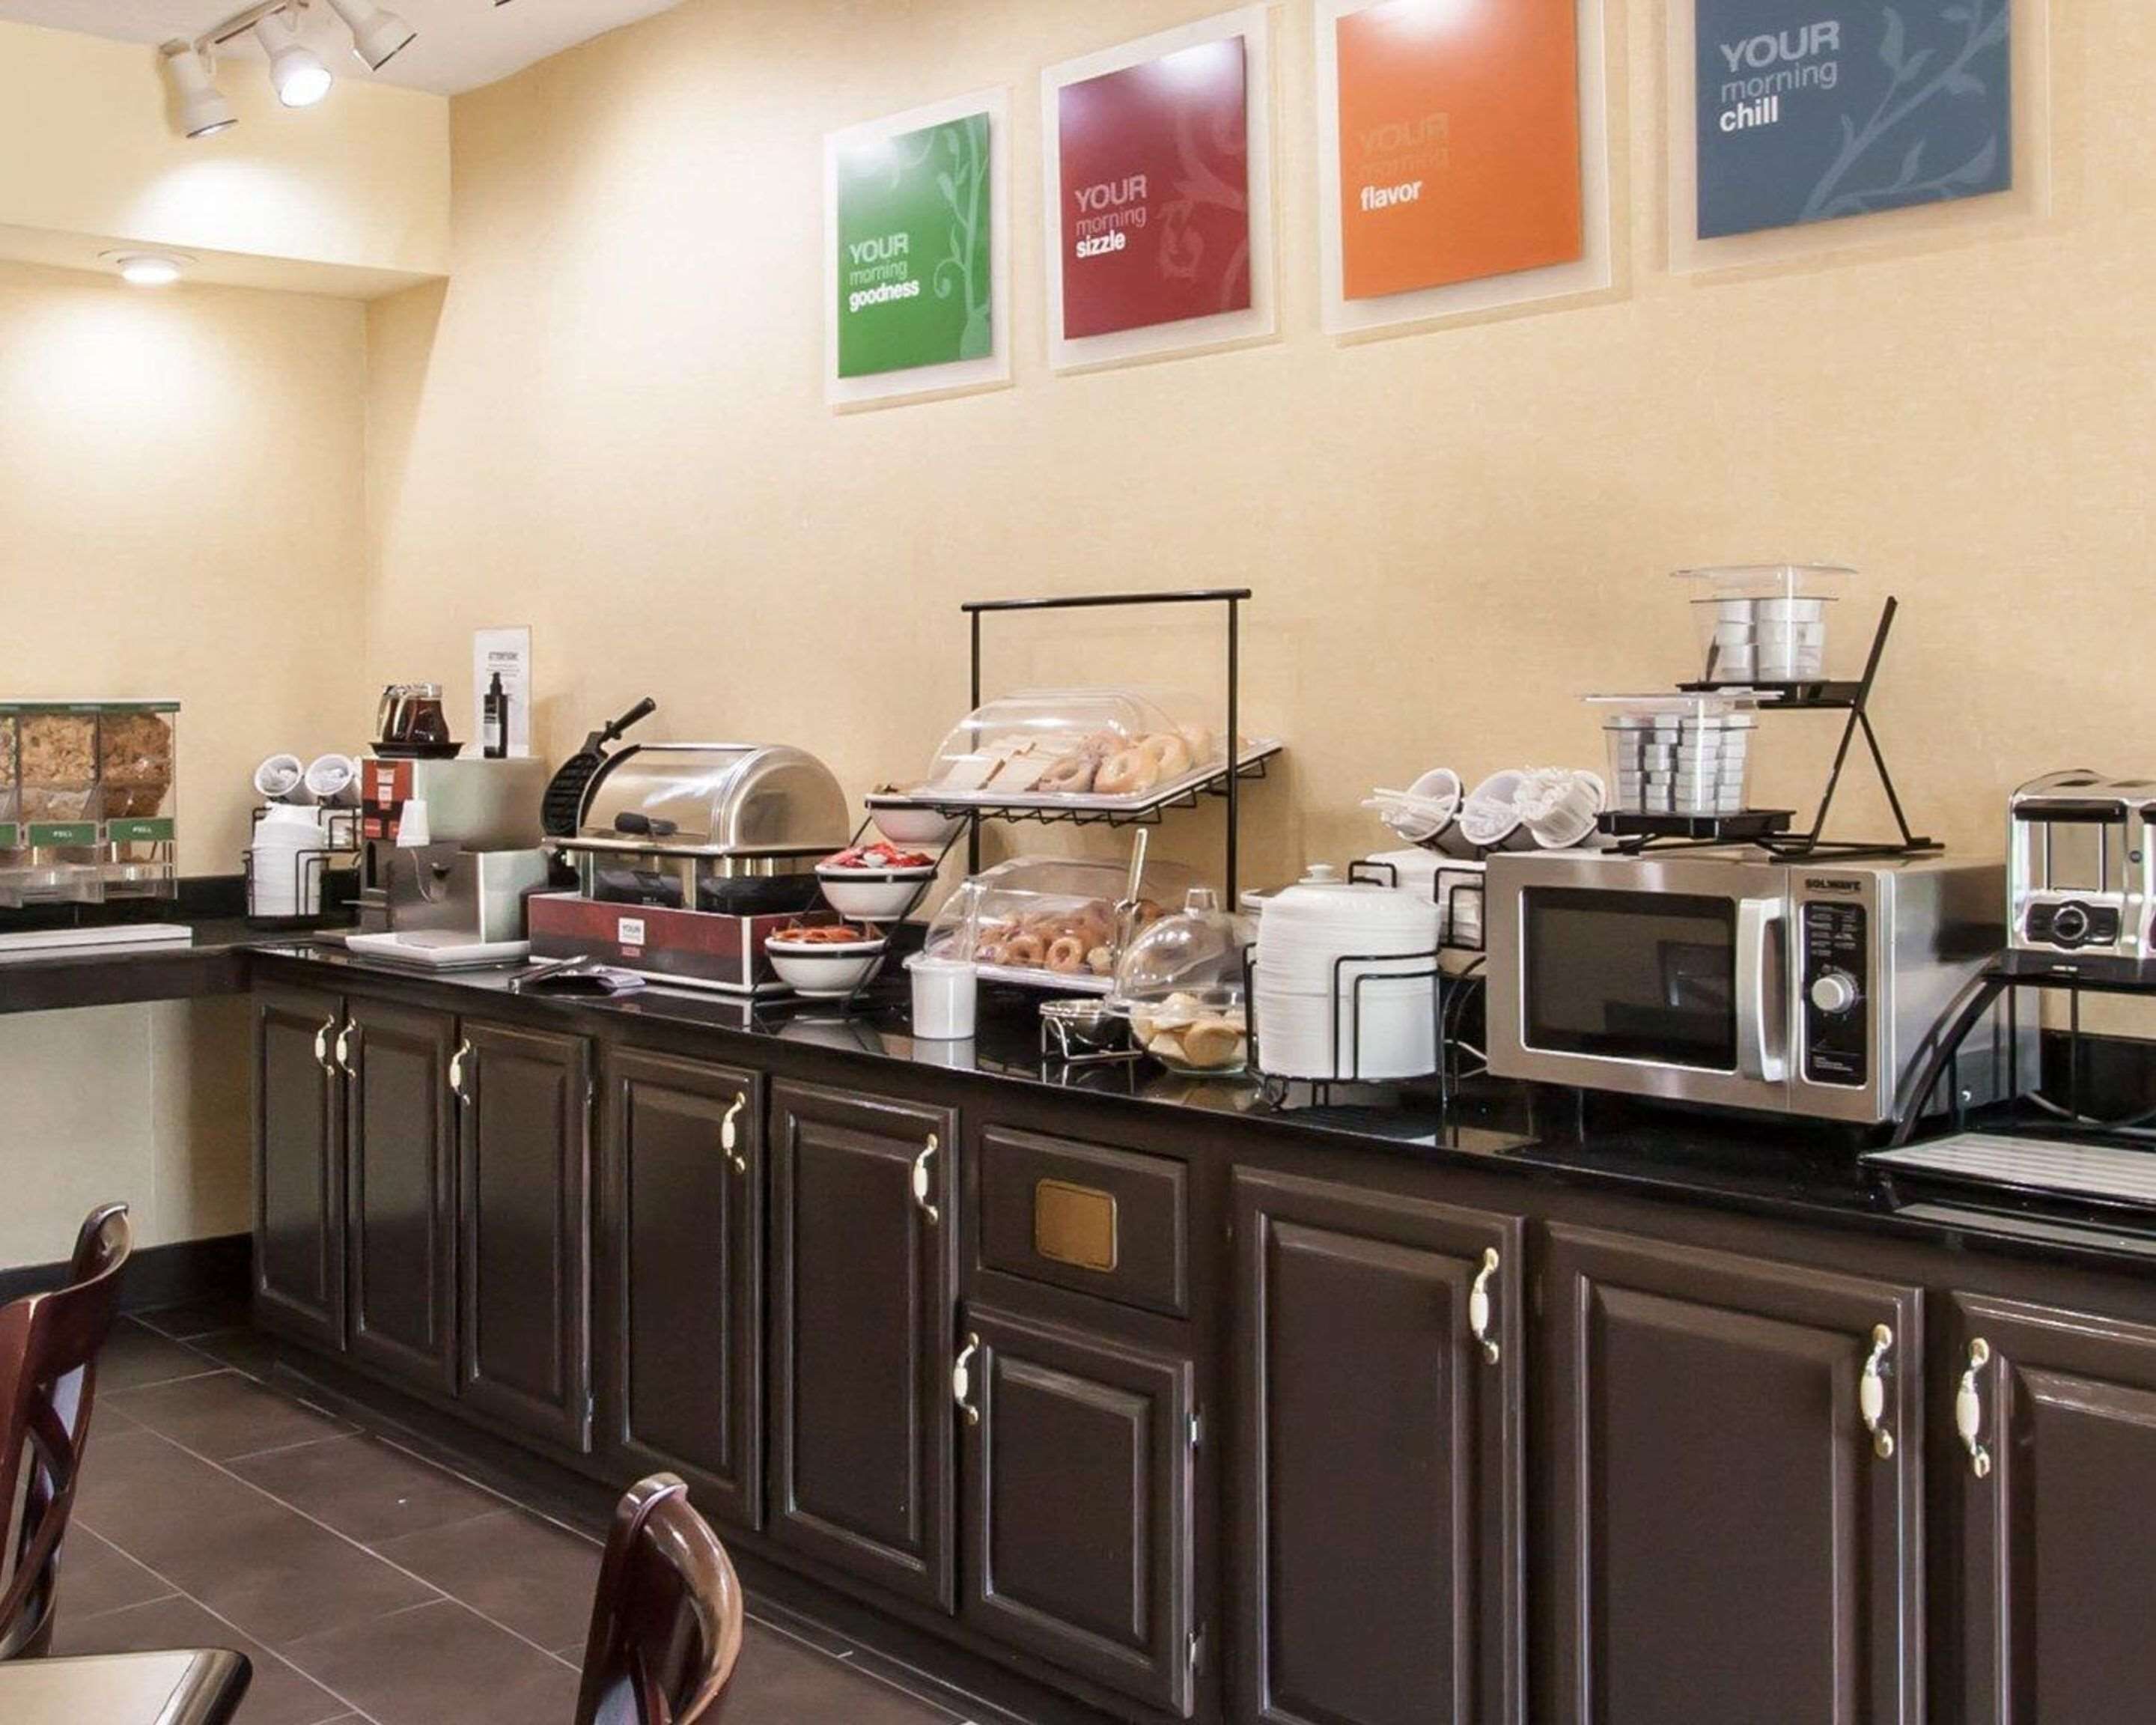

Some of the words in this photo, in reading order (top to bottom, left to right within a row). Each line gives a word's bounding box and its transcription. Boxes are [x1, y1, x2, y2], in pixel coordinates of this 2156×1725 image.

[1720, 20, 1839, 72] YOUR
[1722, 61, 1837, 103] morning
[1720, 95, 1778, 132] chill
[1359, 112, 1449, 156] YOUR
[1074, 174, 1146, 213] YOUR
[1361, 180, 1422, 211] flavor
[1076, 206, 1146, 235] morning
[849, 233, 908, 264] YOUR
[1076, 229, 1126, 258] sizzle
[850, 260, 907, 286] morning
[849, 280, 919, 313] goodness
